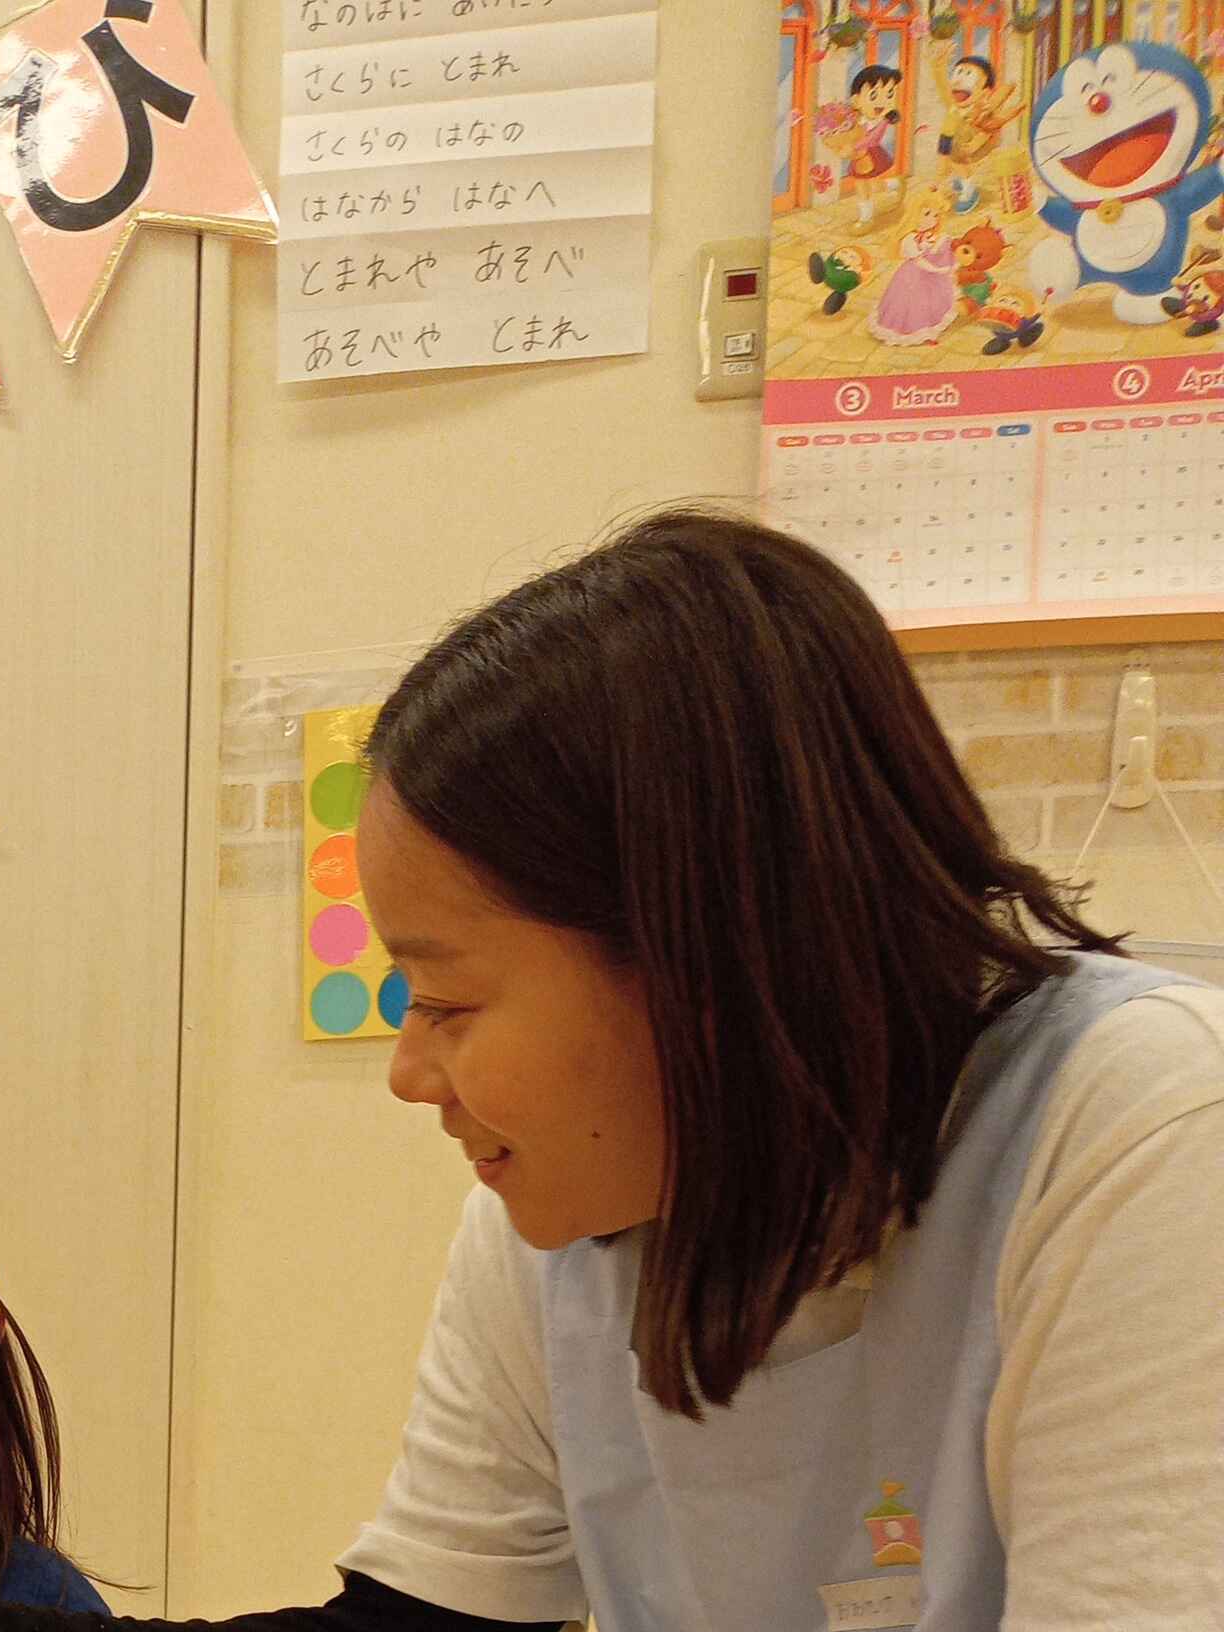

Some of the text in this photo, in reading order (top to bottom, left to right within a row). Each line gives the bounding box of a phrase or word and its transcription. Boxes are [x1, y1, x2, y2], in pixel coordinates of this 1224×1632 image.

[304, 51, 521, 102] さくらに とまれ
[305, 120, 525, 162] さくらの はなの
[301, 179, 557, 223] はなから はなへ
[300, 240, 586, 297] とまれや あそべ
[302, 314, 591, 373] あそべや とまれ
[892, 384, 960, 409] March
